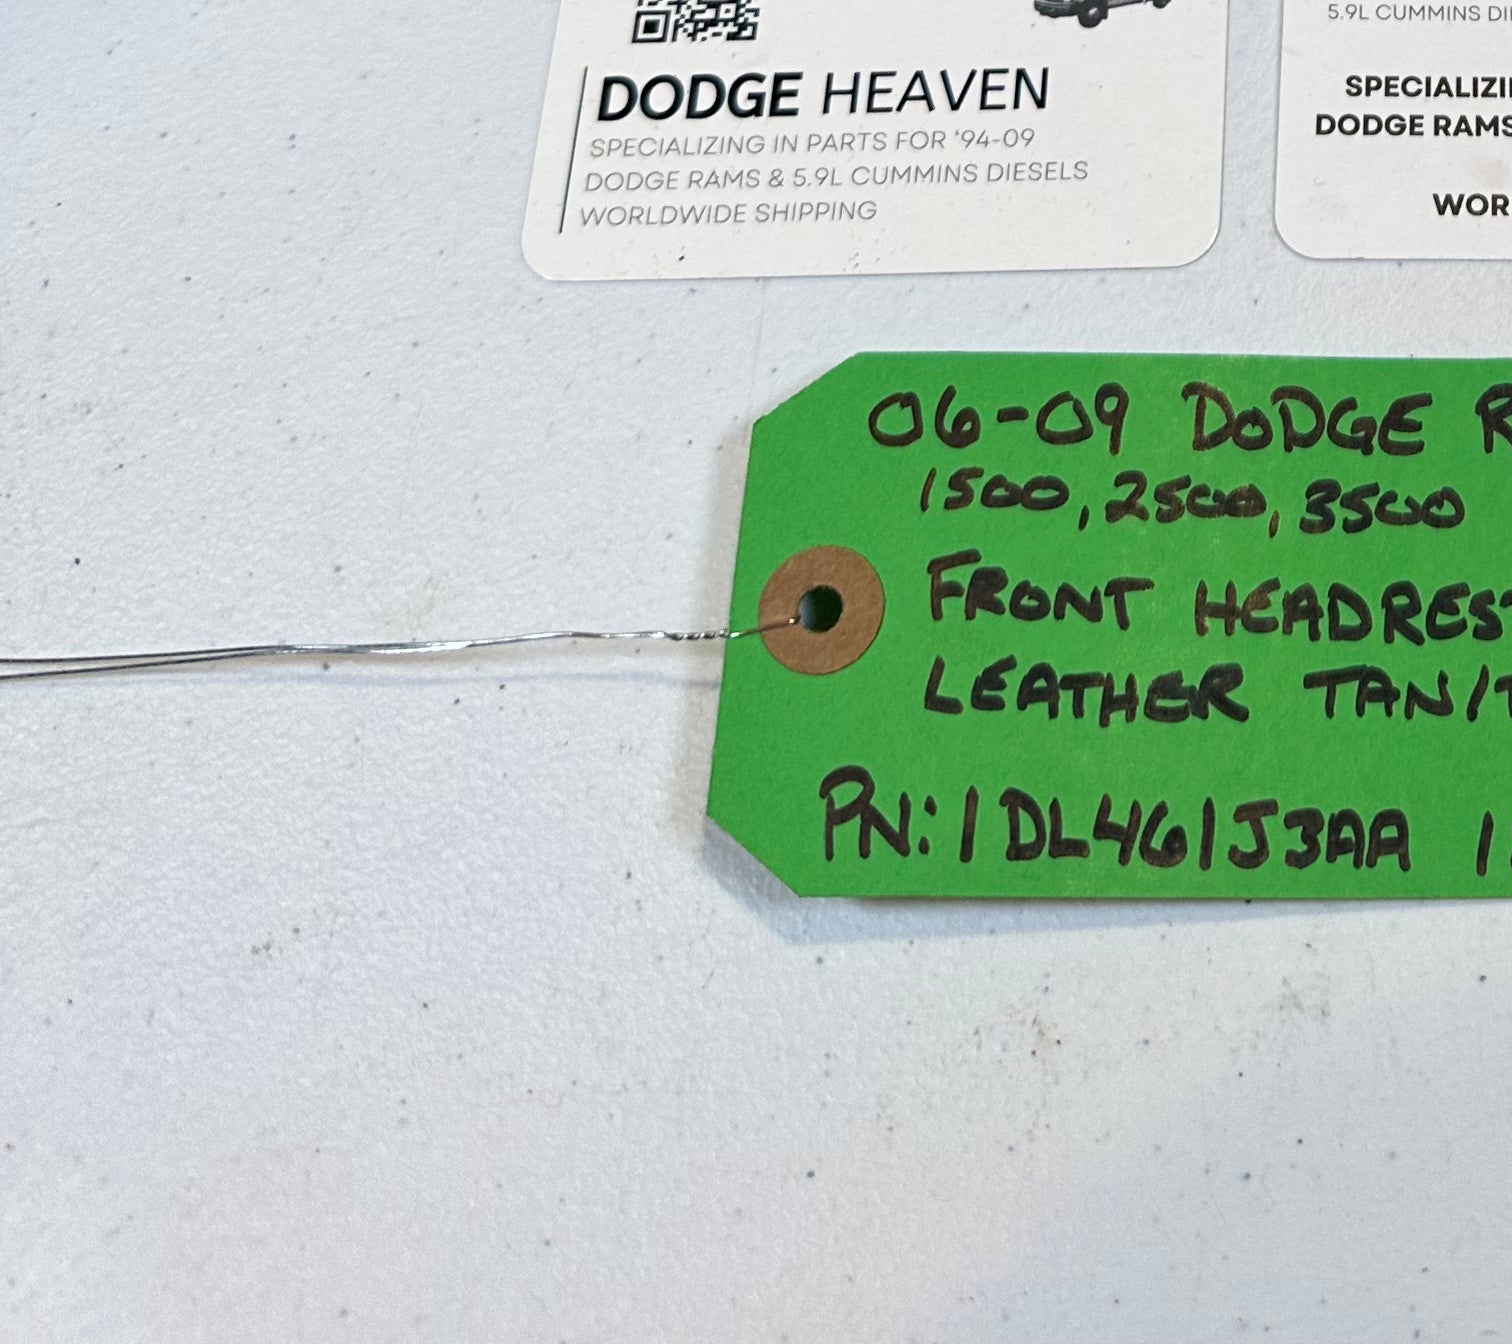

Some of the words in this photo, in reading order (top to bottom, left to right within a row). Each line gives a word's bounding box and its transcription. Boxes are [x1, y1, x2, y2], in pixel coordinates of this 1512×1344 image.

[1328, 4, 1369, 20] 5.9L
[1376, 4, 1480, 21] CUMMINS
[597, 72, 803, 121] DODGE
[822, 67, 1048, 115] HEAVEN
[1316, 114, 1424, 136] DODGE
[590, 135, 765, 158] SPECIALIZING
[773, 134, 798, 153] IN
[807, 132, 887, 152] PARTS
[895, 131, 946, 150] FOR
[584, 171, 680, 192] DODGE
[688, 169, 760, 189] RAMS
[768, 168, 784, 188] &
[793, 167, 842, 187] 5.9L
[851, 164, 978, 185] CUMMINS
[987, 161, 1088, 182] DIESELS
[581, 204, 747, 227] WORLDWIDE
[755, 201, 877, 223] SHIPPING
[868, 383, 1129, 456] 06-09
[927, 549, 1154, 631] FRONT
[924, 655, 1249, 728] LEATHER
